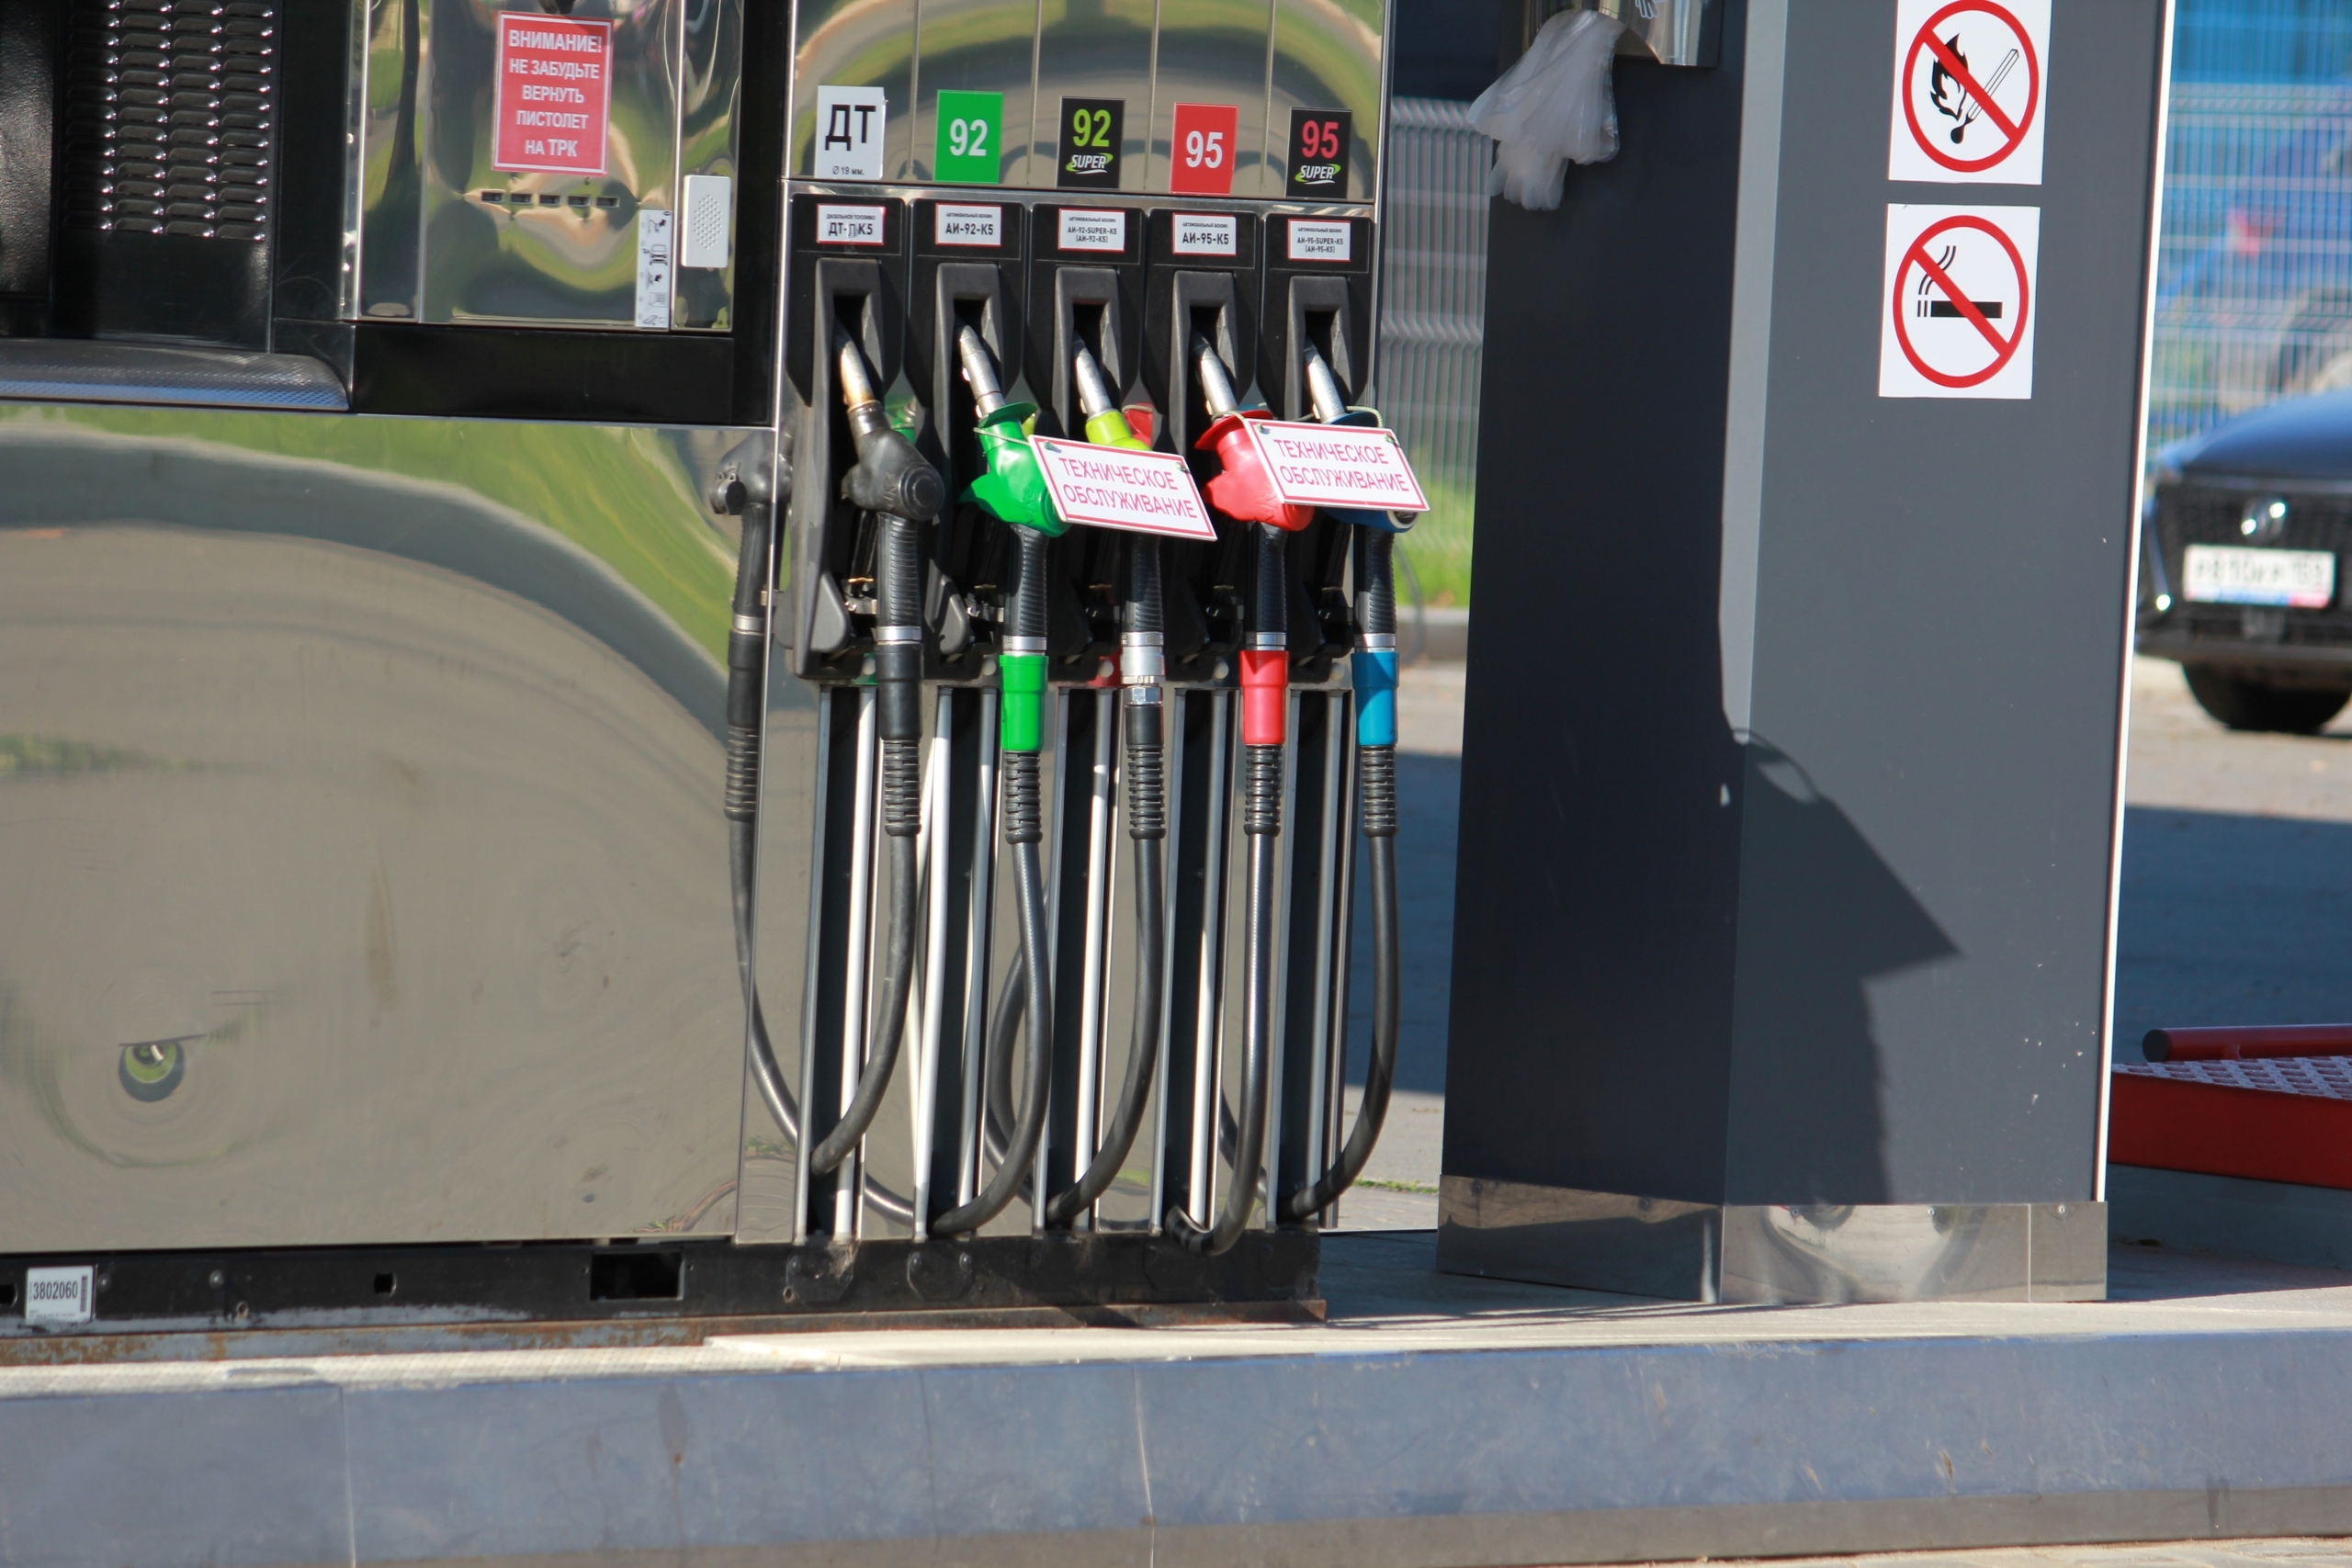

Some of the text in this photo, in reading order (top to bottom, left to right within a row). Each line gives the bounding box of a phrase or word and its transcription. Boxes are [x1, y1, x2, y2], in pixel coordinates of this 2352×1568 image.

[509, 29, 603, 53] ВНИМАНИЕ!
[510, 58, 600, 80] НЕ ЗАБУДЬТЕ
[522, 85, 585, 104] ВЕРНУТЬ
[516, 109, 588, 130] ПИСТОЛЕТ
[825, 104, 876, 152] ДТ
[1073, 108, 1111, 147] 92
[525, 139, 578, 157] НА ТРК
[949, 118, 989, 157] 92
[1302, 120, 1339, 159] 95
[1185, 130, 1223, 169] 95
[841, 166, 850, 175] 19
[1070, 154, 1107, 169] SUPER
[1299, 164, 1335, 180] SUPER
[944, 222, 994, 235] АИ-92-К5
[1182, 231, 1229, 245] АИ-95-К5
[1272, 439, 1390, 465] ТЕХНИЧЕСКОЕ
[1058, 457, 1179, 491] ТЕХНИЧЕСКОЕ
[1280, 465, 1410, 492] ОБСЛУЖИВАНИЕ
[1063, 484, 1198, 519] ОБСЛУЖИВАНИЕ
[33, 1280, 78, 1300] 3802060
